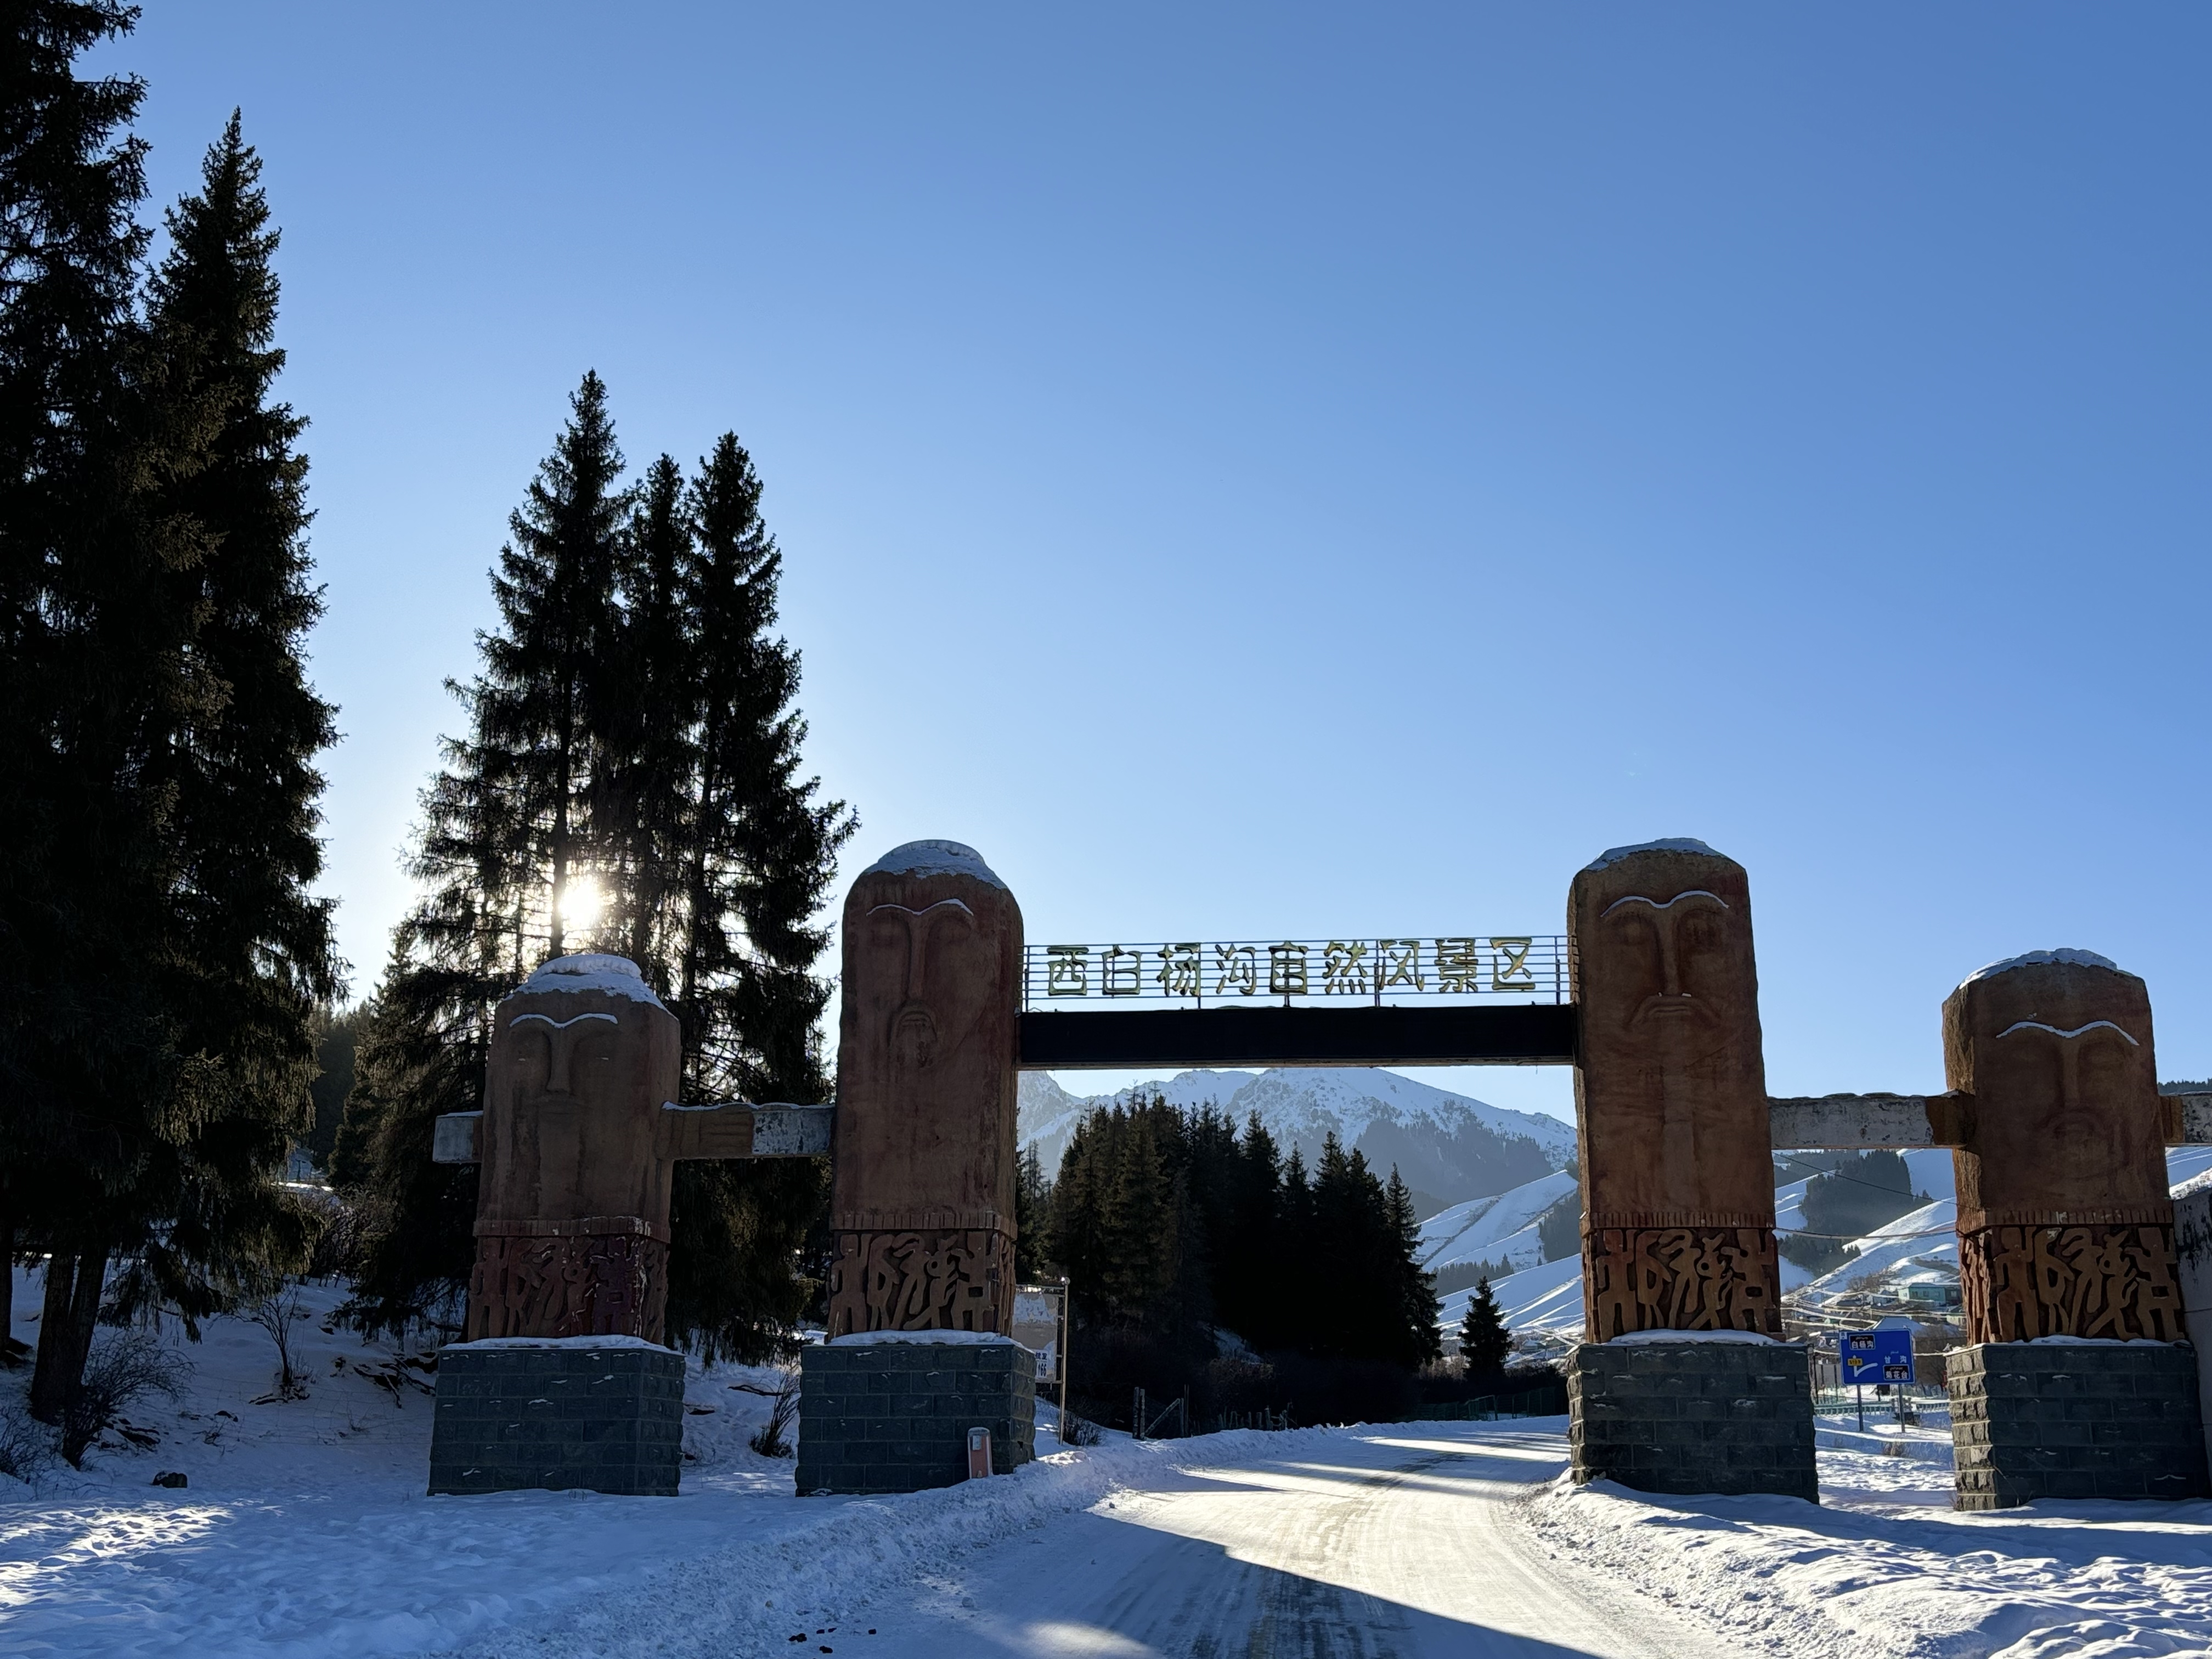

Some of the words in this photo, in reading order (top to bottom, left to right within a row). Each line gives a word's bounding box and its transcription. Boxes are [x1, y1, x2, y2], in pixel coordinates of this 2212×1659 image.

[1047, 937, 1536, 997] 西白杨沟自然风景区
[1885, 1370, 1908, 1379] 菊花台
